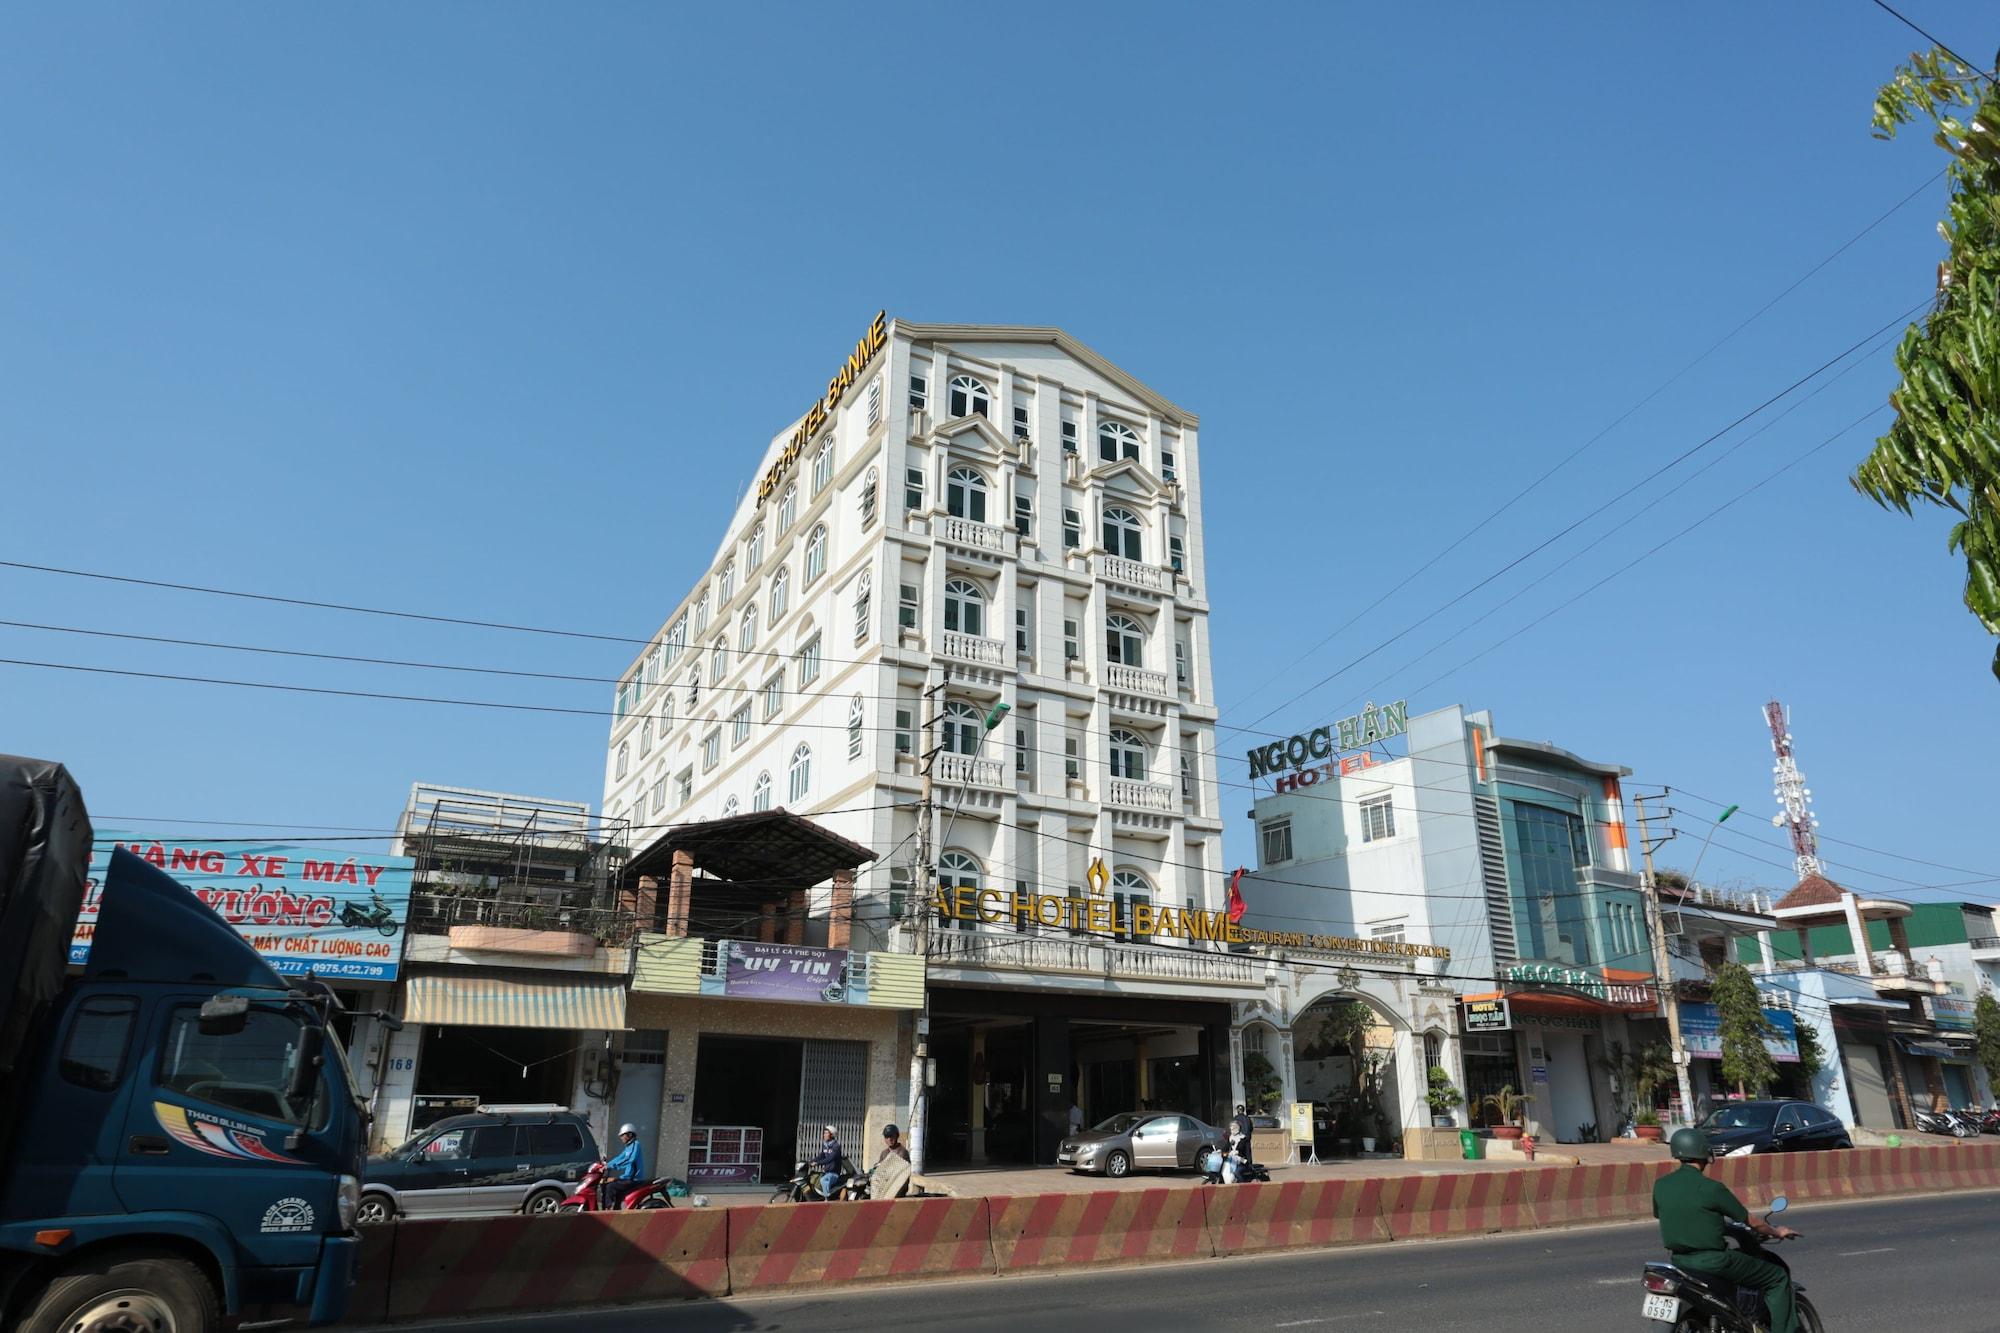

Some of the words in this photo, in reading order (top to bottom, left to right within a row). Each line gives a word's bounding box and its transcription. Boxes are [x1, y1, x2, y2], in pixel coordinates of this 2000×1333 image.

[781, 398, 827, 470] HOTEL
[827, 310, 888, 410] BANME
[1247, 725, 1331, 780] NGỌC
[1336, 699, 1408, 753] HÂN
[1276, 751, 1382, 794] HOTEL
[238, 854, 288, 879] XE
[302, 858, 385, 886] MÁY
[928, 883, 1003, 924] AEC
[1010, 890, 1129, 934] HOTEL
[1132, 903, 1245, 944] BANME
[253, 933, 282, 952] MÁY
[284, 933, 319, 954] CHẤT
[321, 938, 362, 959] LƯỢNG
[365, 943, 390, 957] CAO
[744, 956, 781, 972] UY
[789, 958, 832, 976] TÍN
[389, 1058, 414, 1071] 168
[1647, 1306, 1672, 1320] 0597
